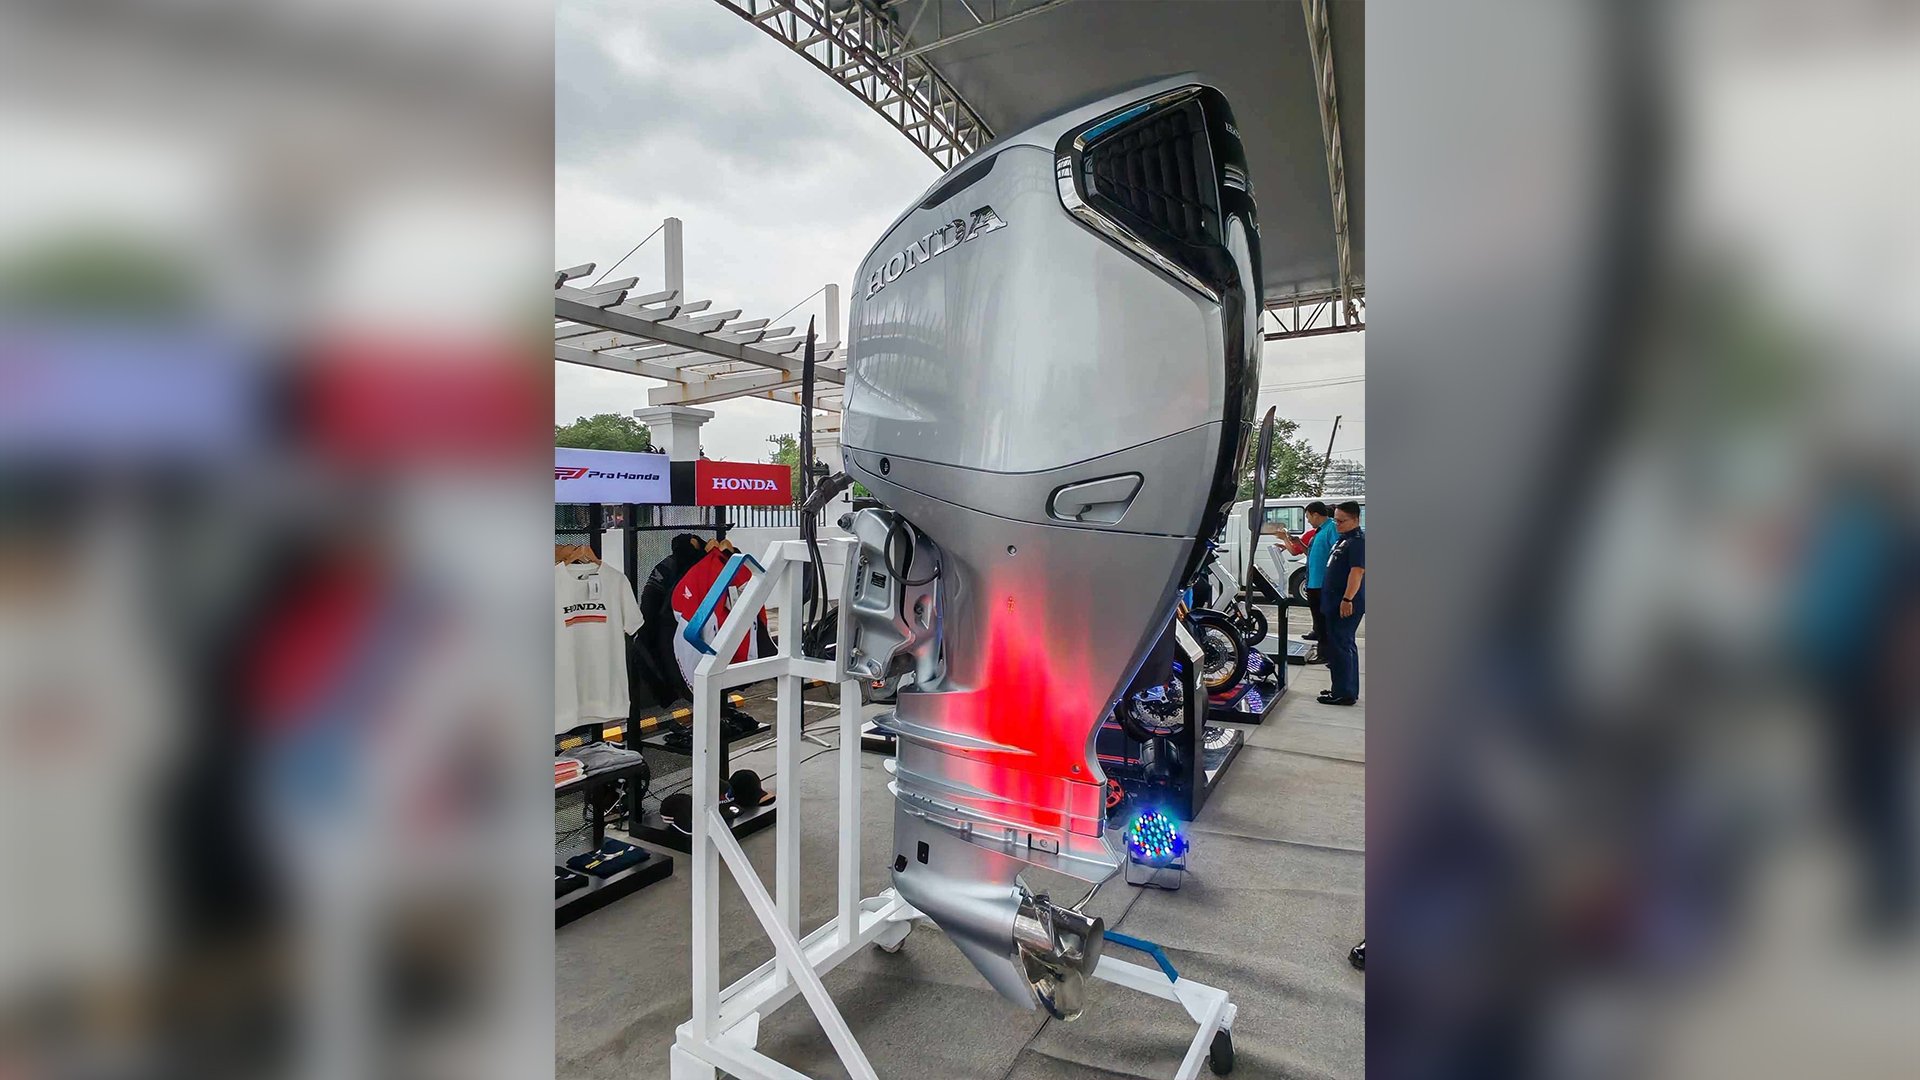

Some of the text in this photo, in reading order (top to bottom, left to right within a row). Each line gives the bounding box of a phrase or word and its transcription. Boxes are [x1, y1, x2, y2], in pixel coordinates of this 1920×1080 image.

[866, 204, 1008, 301] HONDA
[588, 471, 660, 481] Pro Honda
[712, 478, 778, 491] HONDA
